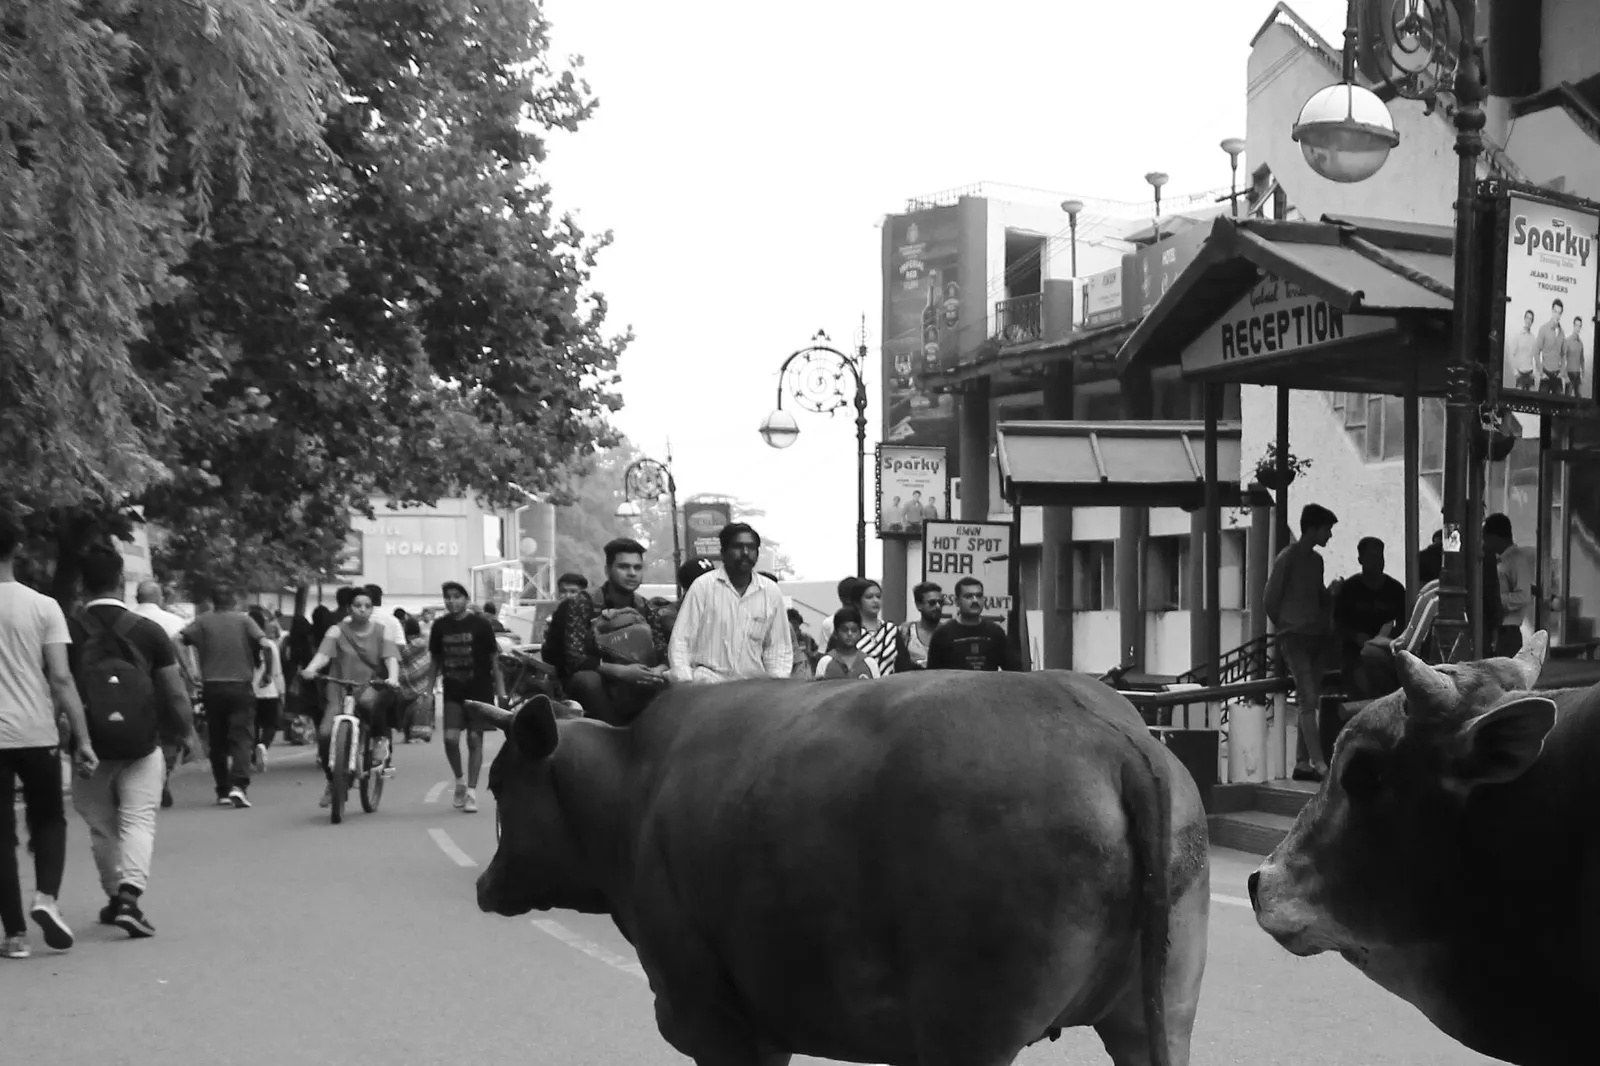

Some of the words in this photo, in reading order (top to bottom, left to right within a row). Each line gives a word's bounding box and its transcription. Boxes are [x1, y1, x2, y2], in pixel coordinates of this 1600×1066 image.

[1514, 216, 1590, 267] Sparky
[1530, 270, 1548, 280] JEANS
[1556, 274, 1577, 285] SHIRTS
[1538, 282, 1568, 294] TROUSERS
[1221, 301, 1344, 360] RECEPTION
[884, 456, 940, 475] Sparky
[385, 541, 459, 556] HOWARD
[932, 536, 960, 550] HOT
[967, 538, 1002, 552] SPOT
[928, 552, 973, 574] BAR
